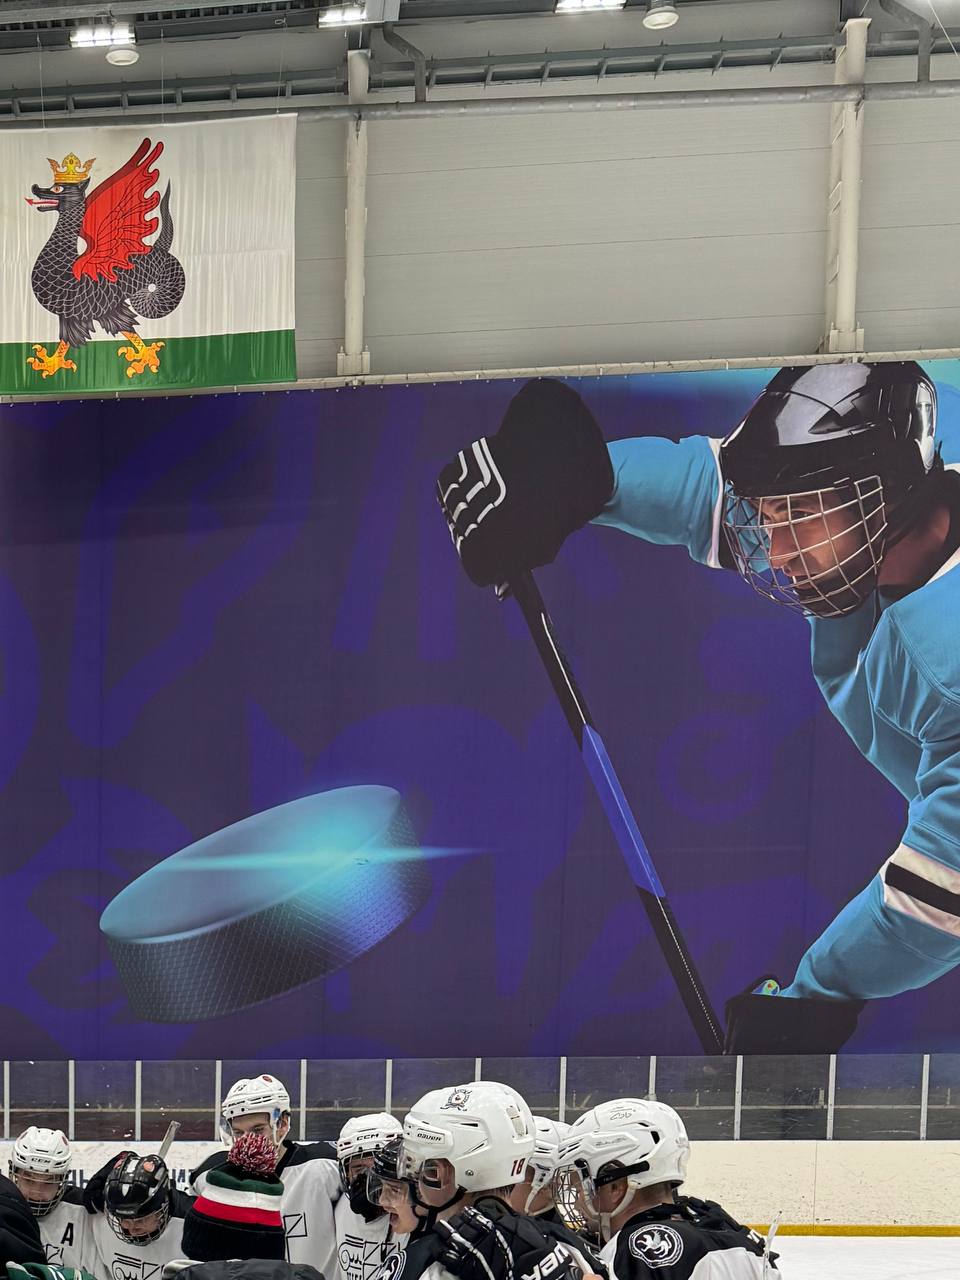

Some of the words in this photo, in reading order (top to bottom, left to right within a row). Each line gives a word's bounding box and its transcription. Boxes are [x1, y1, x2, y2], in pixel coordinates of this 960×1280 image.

[356, 1133, 379, 1141] CCM
[510, 1158, 526, 1177] 18
[60, 1222, 74, 1247] A
